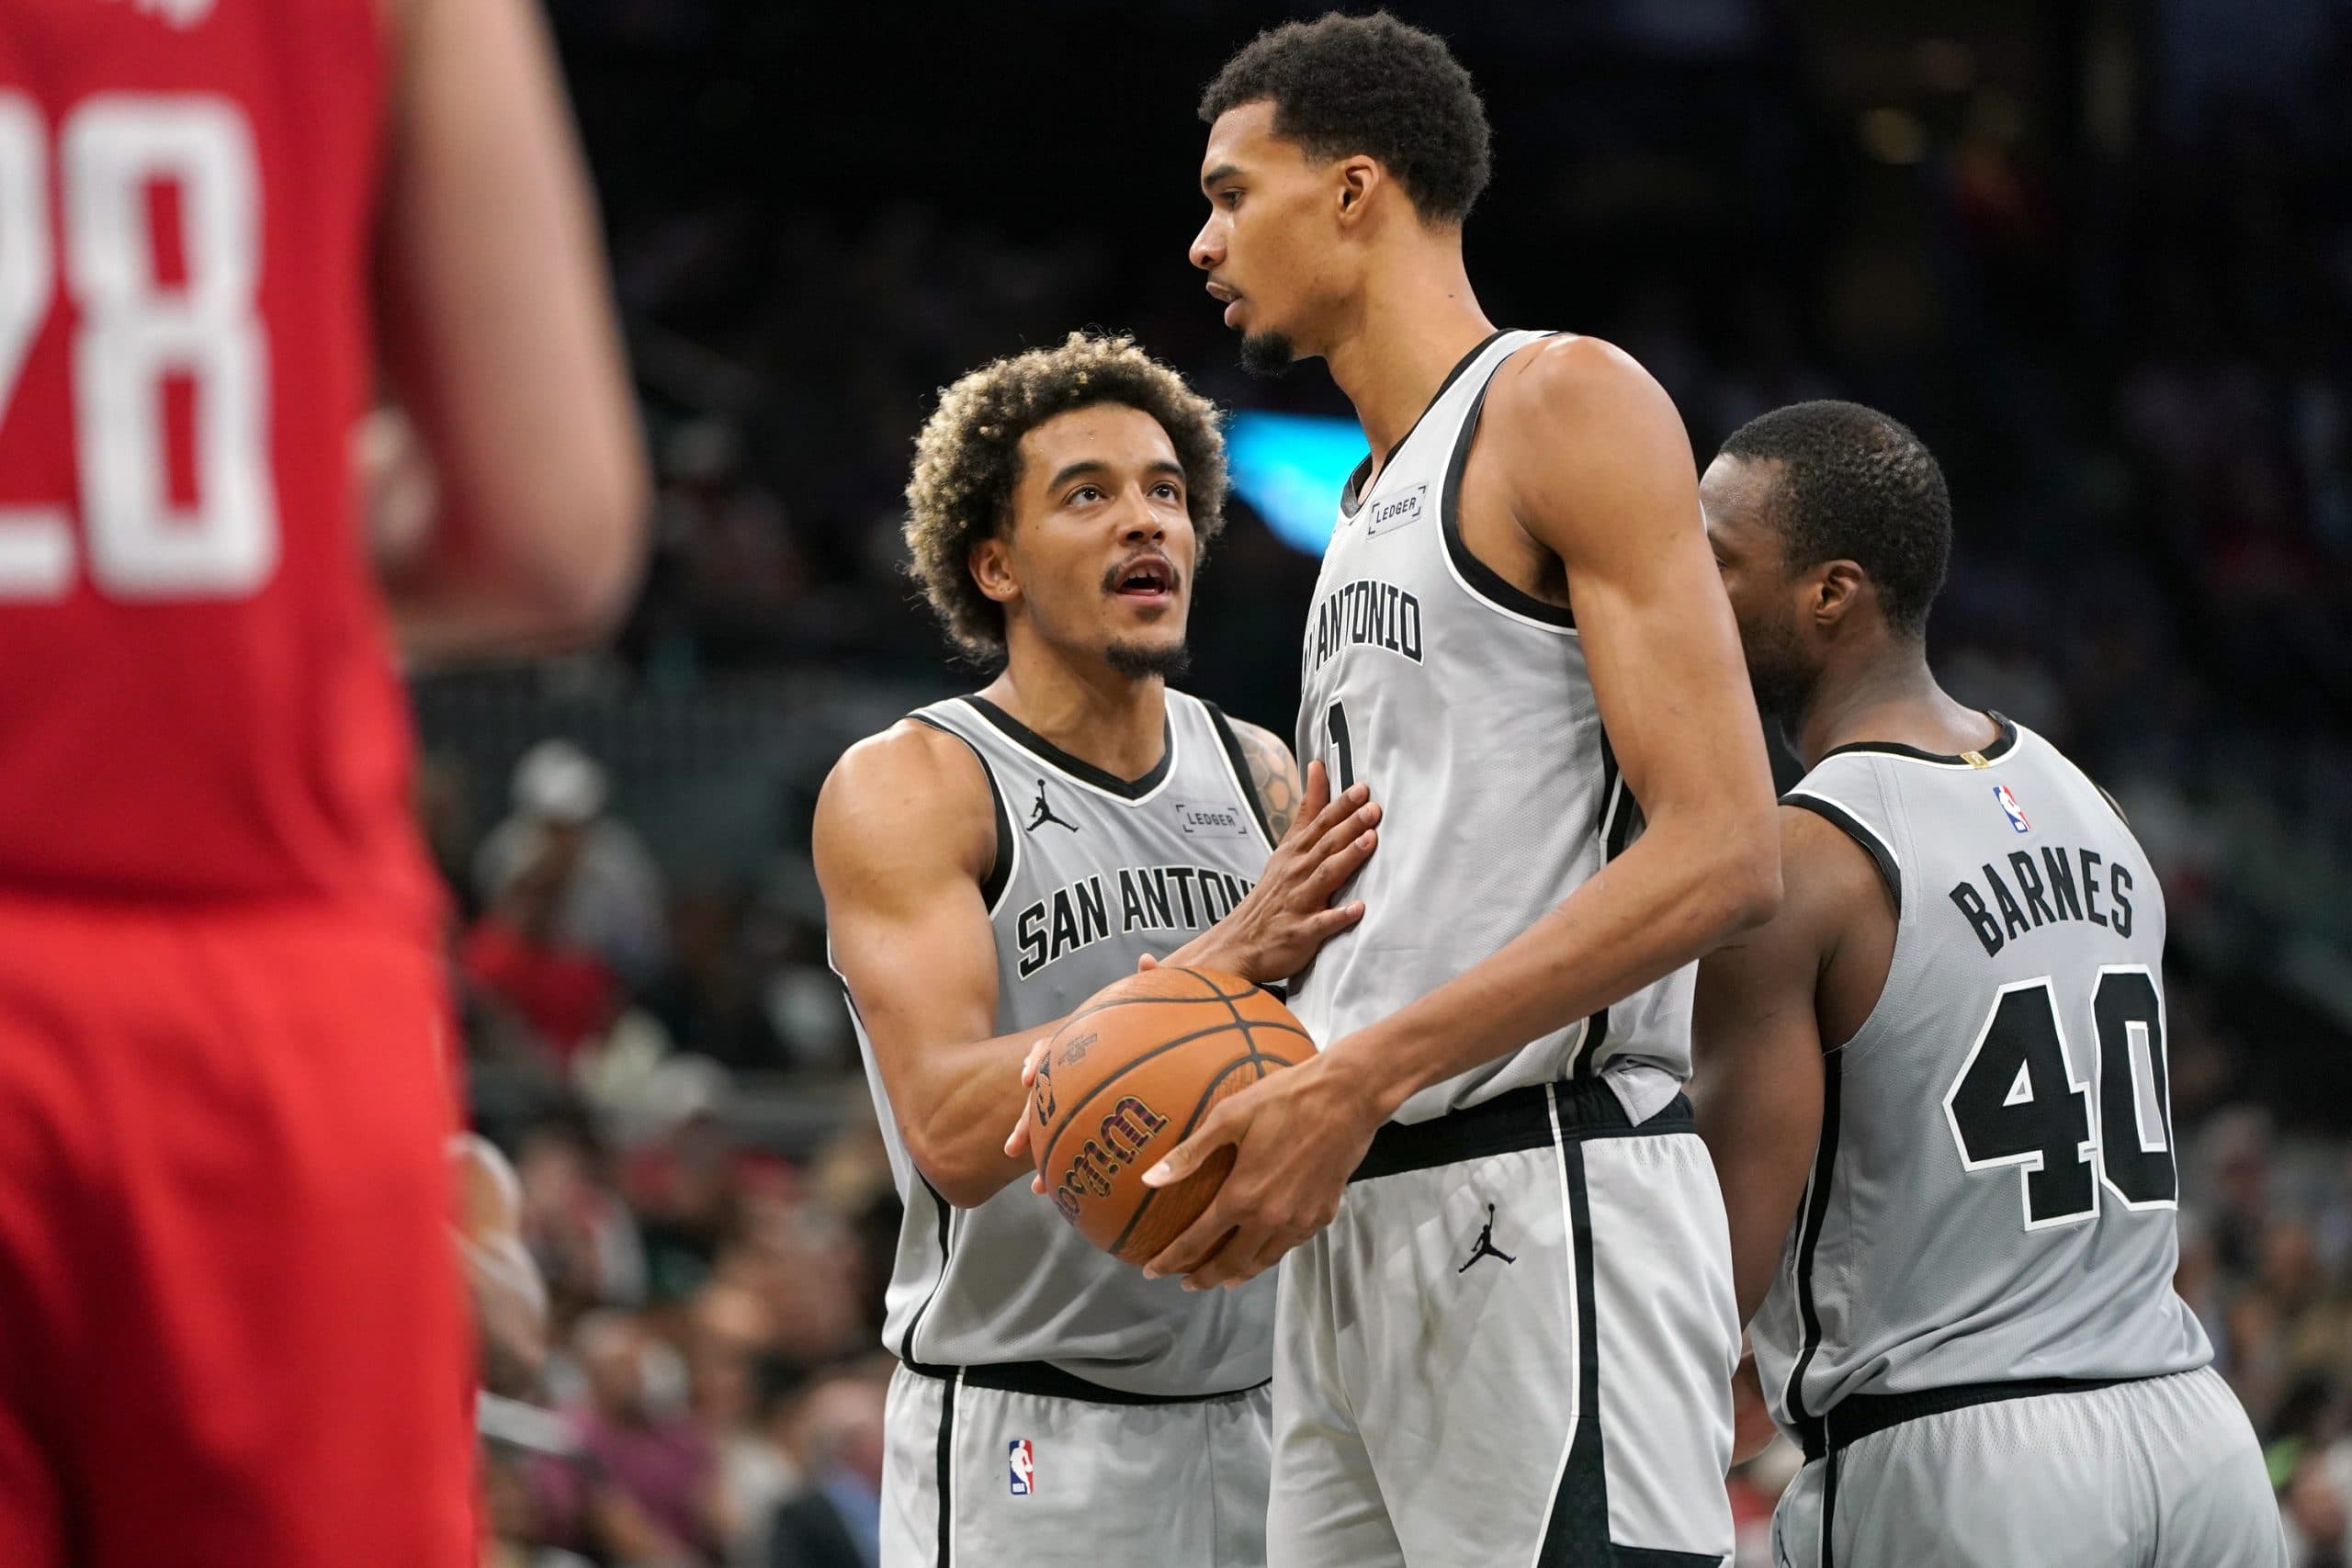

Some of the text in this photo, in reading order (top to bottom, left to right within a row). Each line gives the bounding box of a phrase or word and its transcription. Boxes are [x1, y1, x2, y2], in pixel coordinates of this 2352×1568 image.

[1375, 497, 1417, 524] LEDGER
[1315, 578, 1424, 676] ANTONIO
[1326, 697, 1356, 794] 1
[1186, 812, 1236, 827] LEDGER
[1016, 864, 1257, 981] SAN ANTON
[1949, 846, 2133, 958] BARNES
[1942, 964, 2179, 1232] 40
